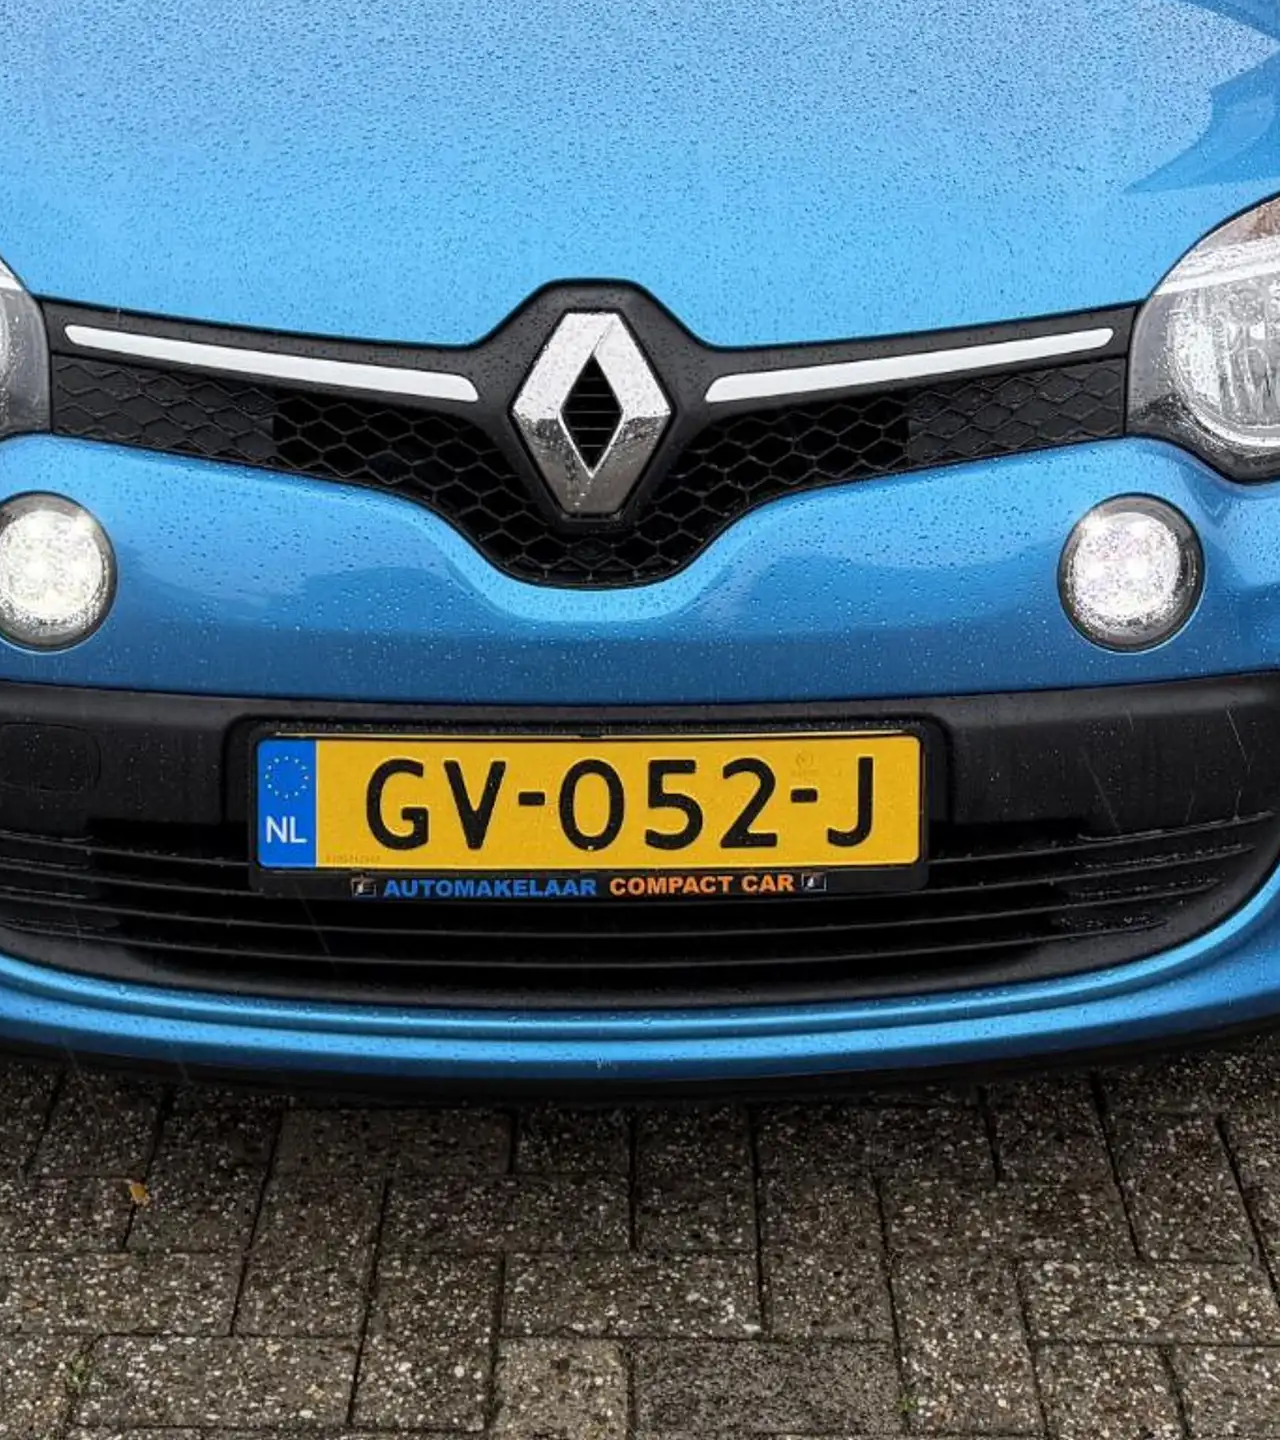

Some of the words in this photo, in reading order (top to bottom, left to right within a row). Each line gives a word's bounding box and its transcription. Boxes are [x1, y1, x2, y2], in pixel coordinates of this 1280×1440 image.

[366, 758, 874, 850] GV-052-J
[267, 817, 306, 843] NL
[384, 877, 597, 898] AUTOMAKELAAR
[610, 876, 733, 895] COMPACT
[741, 873, 794, 892] CAR
